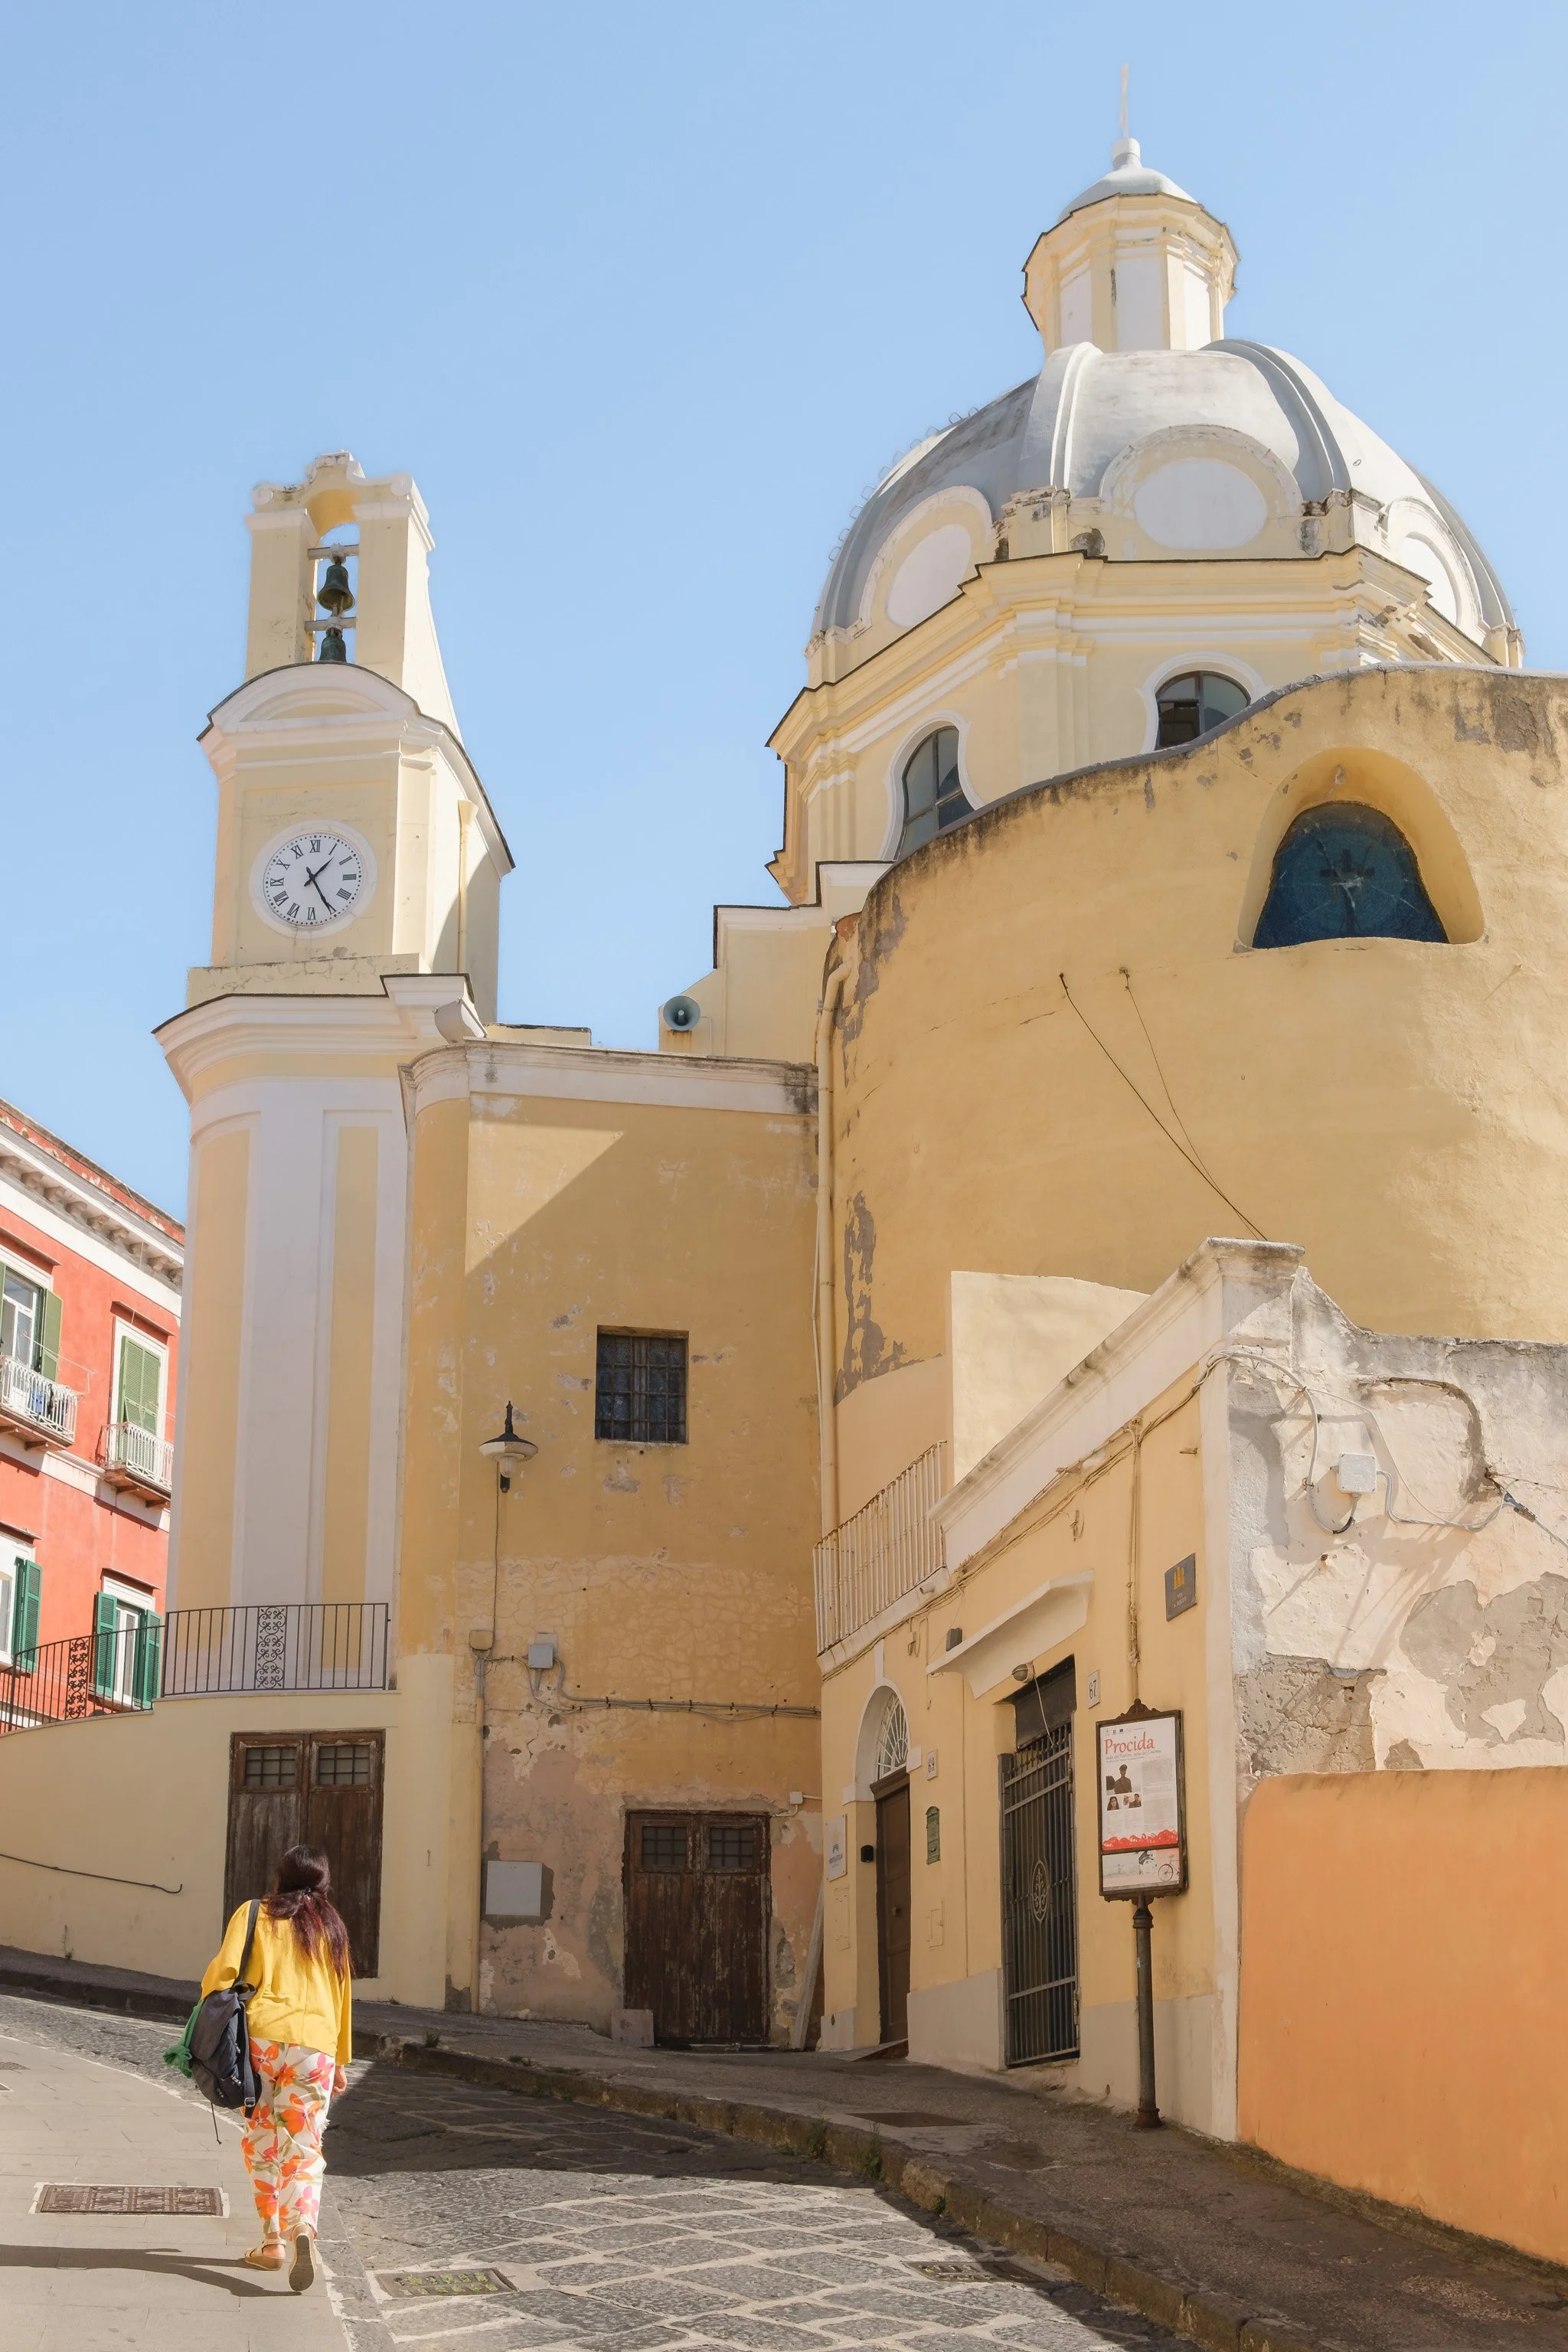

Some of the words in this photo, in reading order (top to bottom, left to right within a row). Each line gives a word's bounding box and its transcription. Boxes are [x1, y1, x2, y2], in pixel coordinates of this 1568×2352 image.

[290, 844, 304, 860] XI
[310, 839, 321, 853] XII
[276, 859, 290, 871] X
[270, 877, 285, 887] IX
[273, 890, 289, 906] VIII
[286, 902, 301, 919] VII
[307, 906, 317, 921] VI
[1089, 1678, 1097, 1700] 67
[1104, 1731, 1155, 1755] Procida
[928, 1756, 935, 1774] 69
